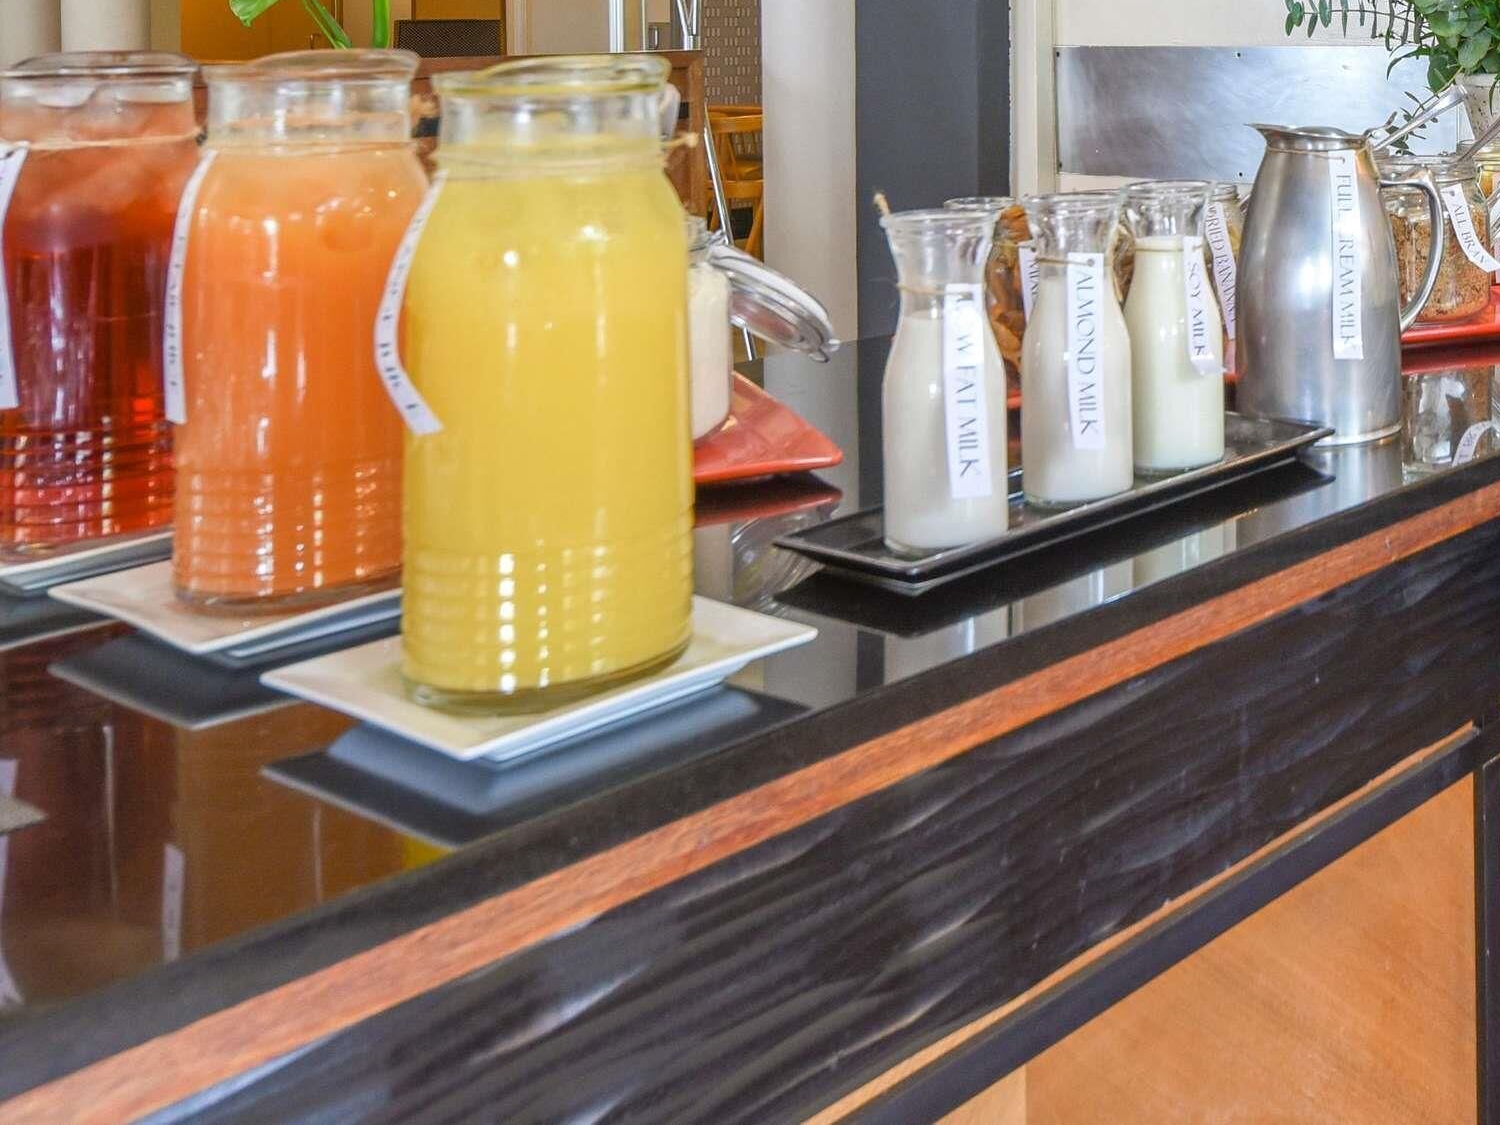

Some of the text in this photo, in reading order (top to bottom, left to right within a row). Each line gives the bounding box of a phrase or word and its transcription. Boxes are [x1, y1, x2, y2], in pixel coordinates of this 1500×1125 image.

[1337, 174, 1353, 219] FULL
[1339, 229, 1355, 296] REAM
[1075, 269, 1100, 435] ALMOND MILK
[1193, 308, 1206, 357] MILK
[956, 365, 977, 404] FAT
[958, 415, 983, 478] MILK
